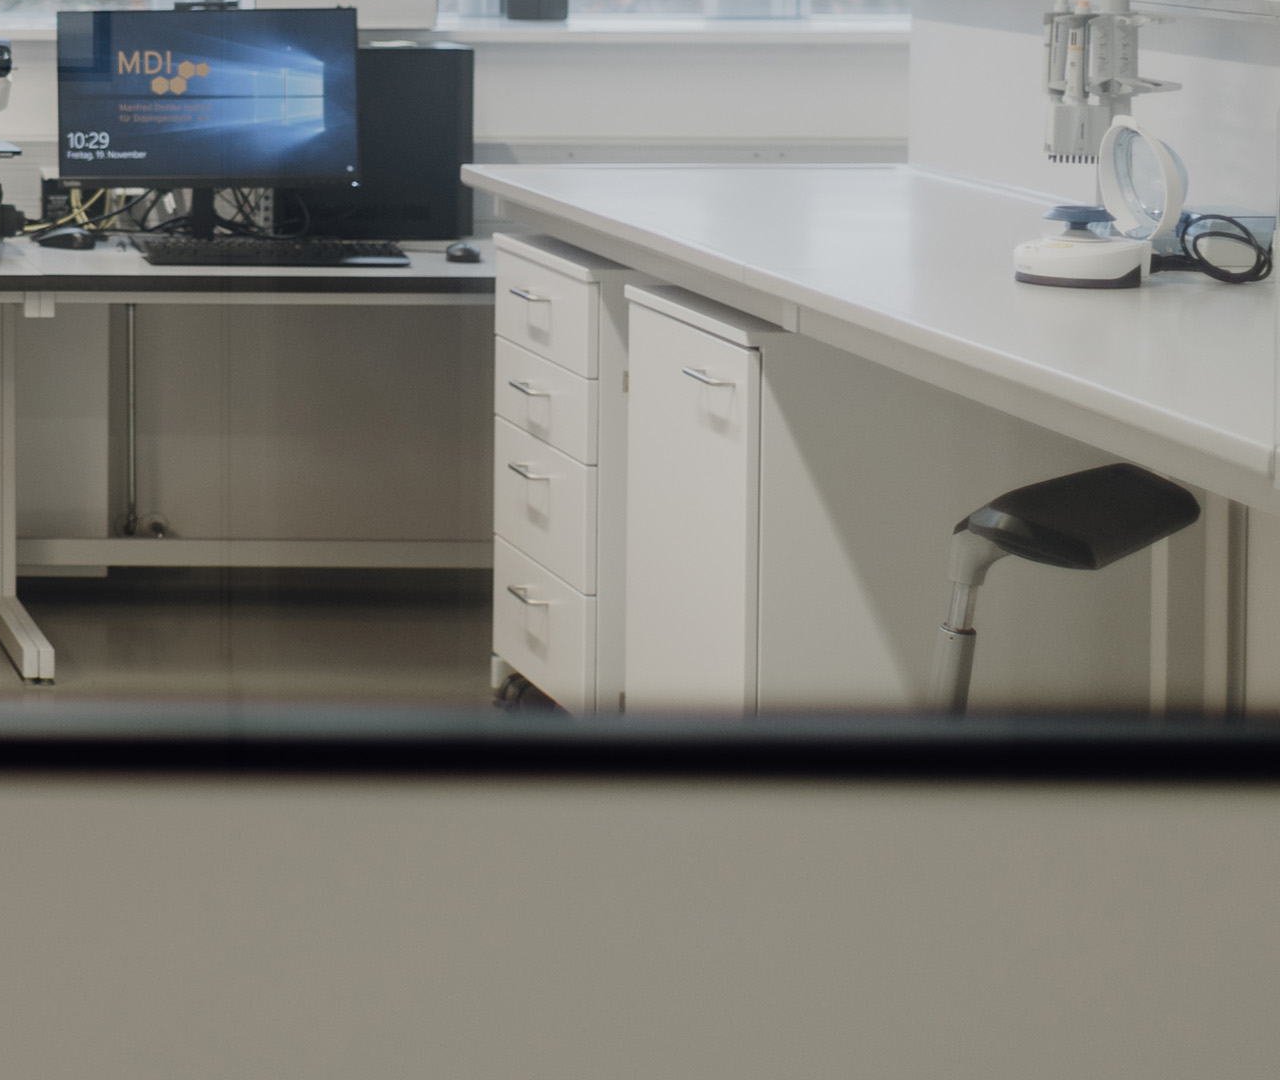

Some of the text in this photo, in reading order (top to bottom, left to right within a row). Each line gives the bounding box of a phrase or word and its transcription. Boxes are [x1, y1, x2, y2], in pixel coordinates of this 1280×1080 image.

[118, 50, 171, 74] MDI
[67, 131, 110, 149] 10:29
[107, 150, 147, 159] November
